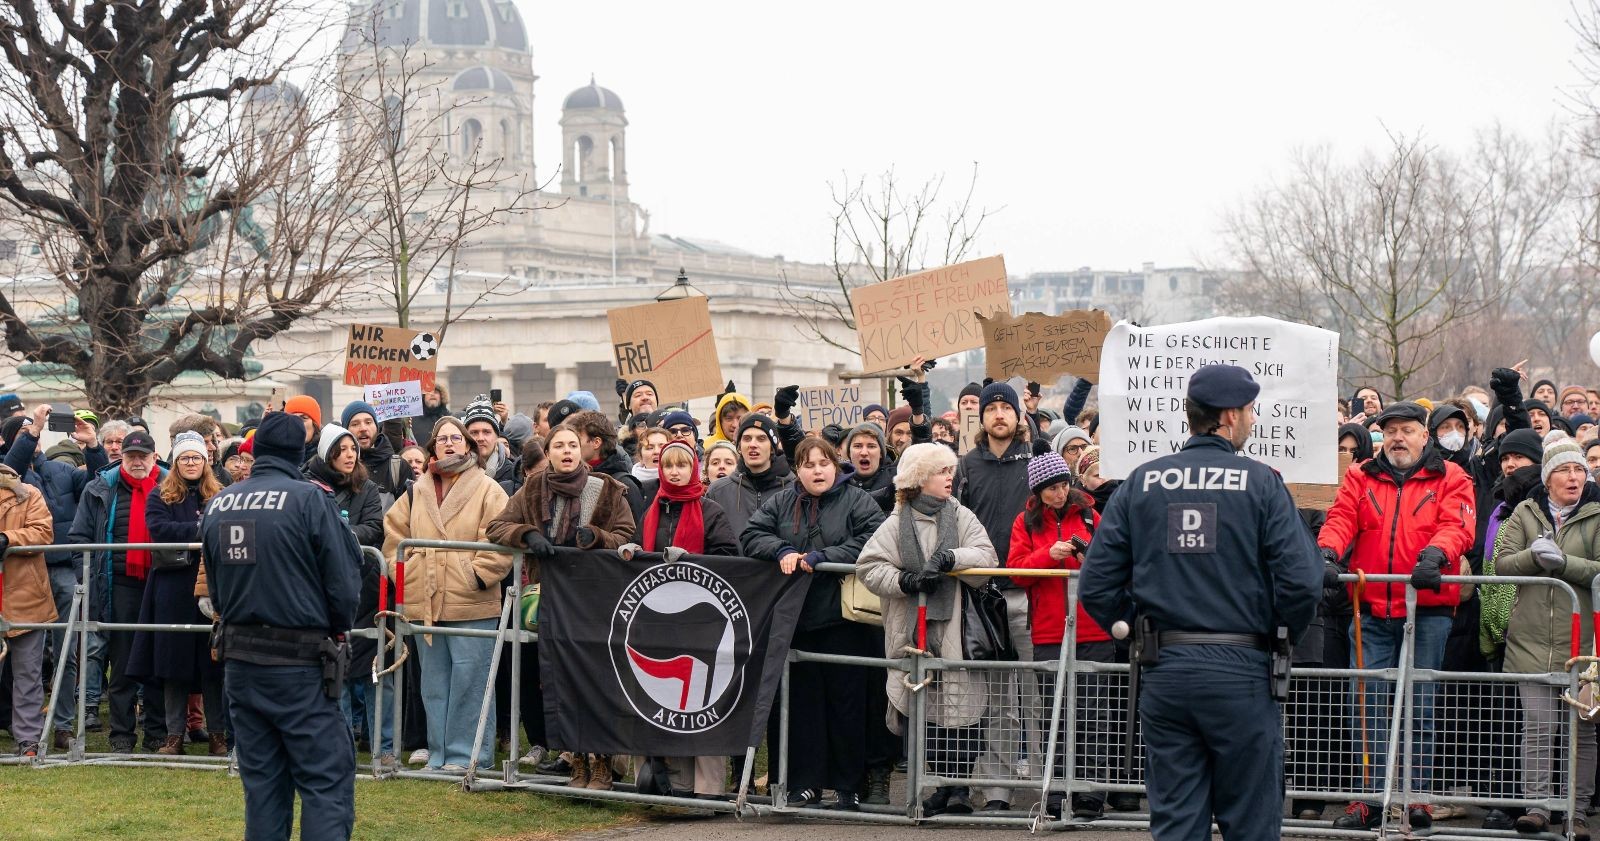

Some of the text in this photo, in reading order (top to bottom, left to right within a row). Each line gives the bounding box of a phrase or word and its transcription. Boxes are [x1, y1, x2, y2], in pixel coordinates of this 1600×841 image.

[892, 268, 969, 295] ZIEMLICH
[858, 278, 1006, 327] BESTE FREUNDE
[352, 324, 384, 343] WIR
[860, 319, 929, 366] KICKL
[1128, 333, 1272, 351] DIE GESCHICHTE
[350, 344, 411, 363] KICKEN
[615, 340, 653, 376] FREI
[1021, 341, 1044, 358] MIT
[1253, 361, 1284, 378] SICH
[1128, 376, 1185, 391] NICHT
[372, 388, 406, 399] ES WIRD
[800, 387, 860, 408] NEIN ZU
[808, 403, 863, 429] FPÖVP
[1271, 403, 1307, 420] SICH
[1128, 419, 1168, 434] NUR
[1128, 439, 1158, 454] DIE
[1142, 467, 1249, 492] POLIZEI
[207, 490, 288, 516] POLIZEI
[1182, 509, 1202, 531] D
[230, 525, 245, 545] D
[1177, 533, 1205, 548] 151
[227, 547, 248, 560] 151
[618, 566, 744, 622] ANTIFASCHISTISCHE
[652, 707, 720, 729] AKTION
